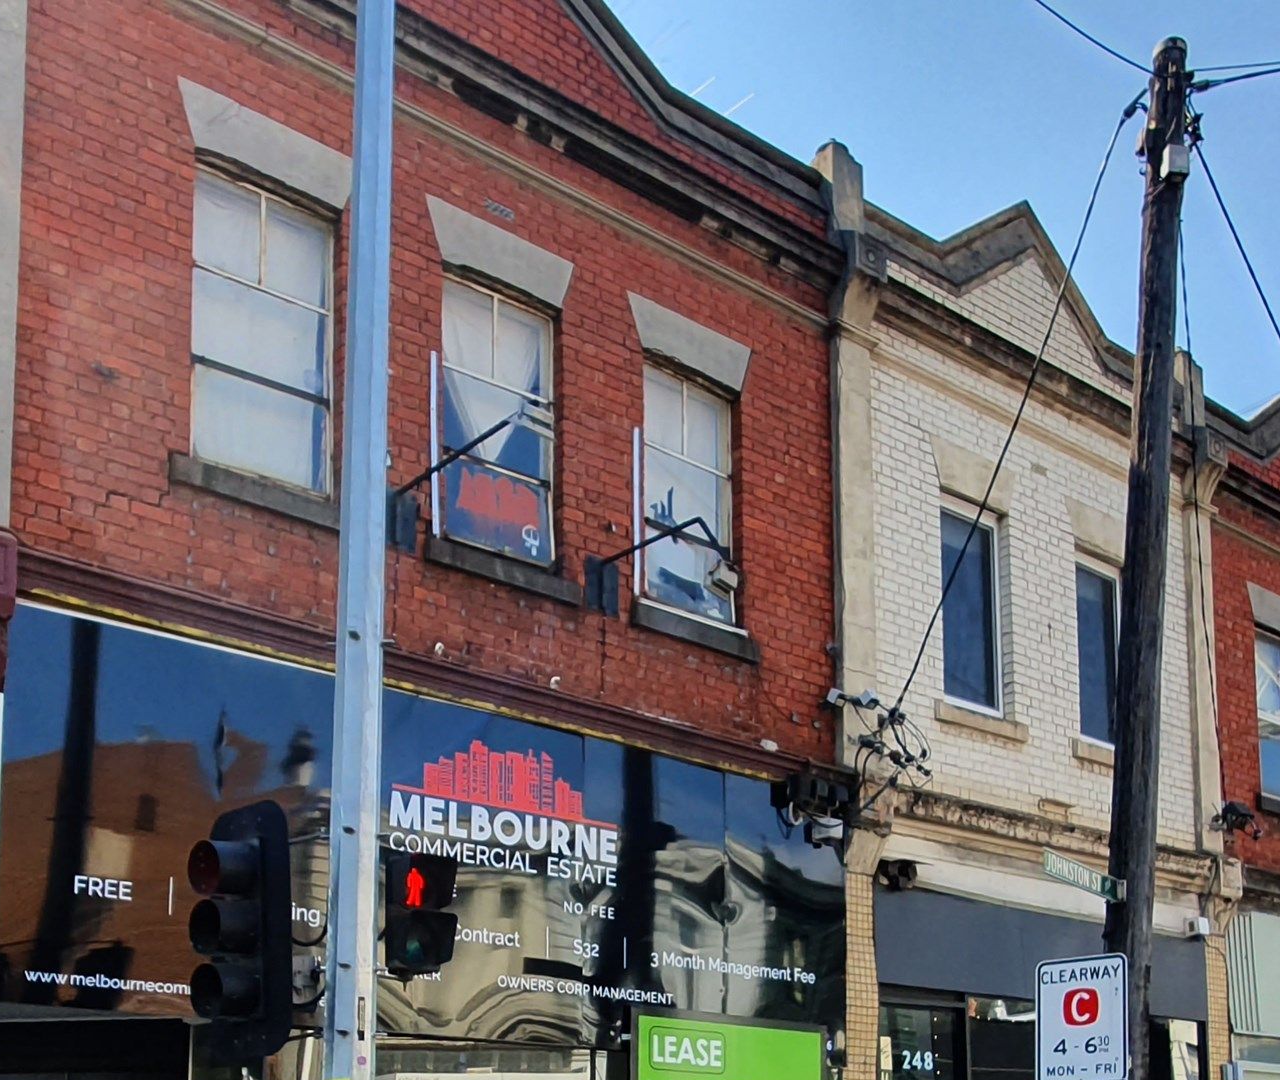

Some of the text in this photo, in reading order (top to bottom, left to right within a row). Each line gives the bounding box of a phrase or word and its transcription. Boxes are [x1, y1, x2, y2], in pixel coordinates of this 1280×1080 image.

[389, 791, 618, 864] MELBOURNE
[389, 831, 617, 887] COMMERCIAL ESTATE
[1046, 853, 1101, 892] JOHNSTON ST
[73, 875, 133, 901] FREE
[563, 901, 615, 920] NO FEE
[650, 951, 816, 984] 3 Month Management Fee
[1041, 964, 1121, 985] CLEARWAY
[497, 975, 674, 1005] OWNERS CORP MANAGEMENT
[652, 1034, 722, 1068] LEASE
[1053, 1038, 1067, 1055] 4
[902, 1051, 934, 1071] 248
[1046, 1066, 1075, 1077] MON
[1095, 1062, 1117, 1074] FRI
